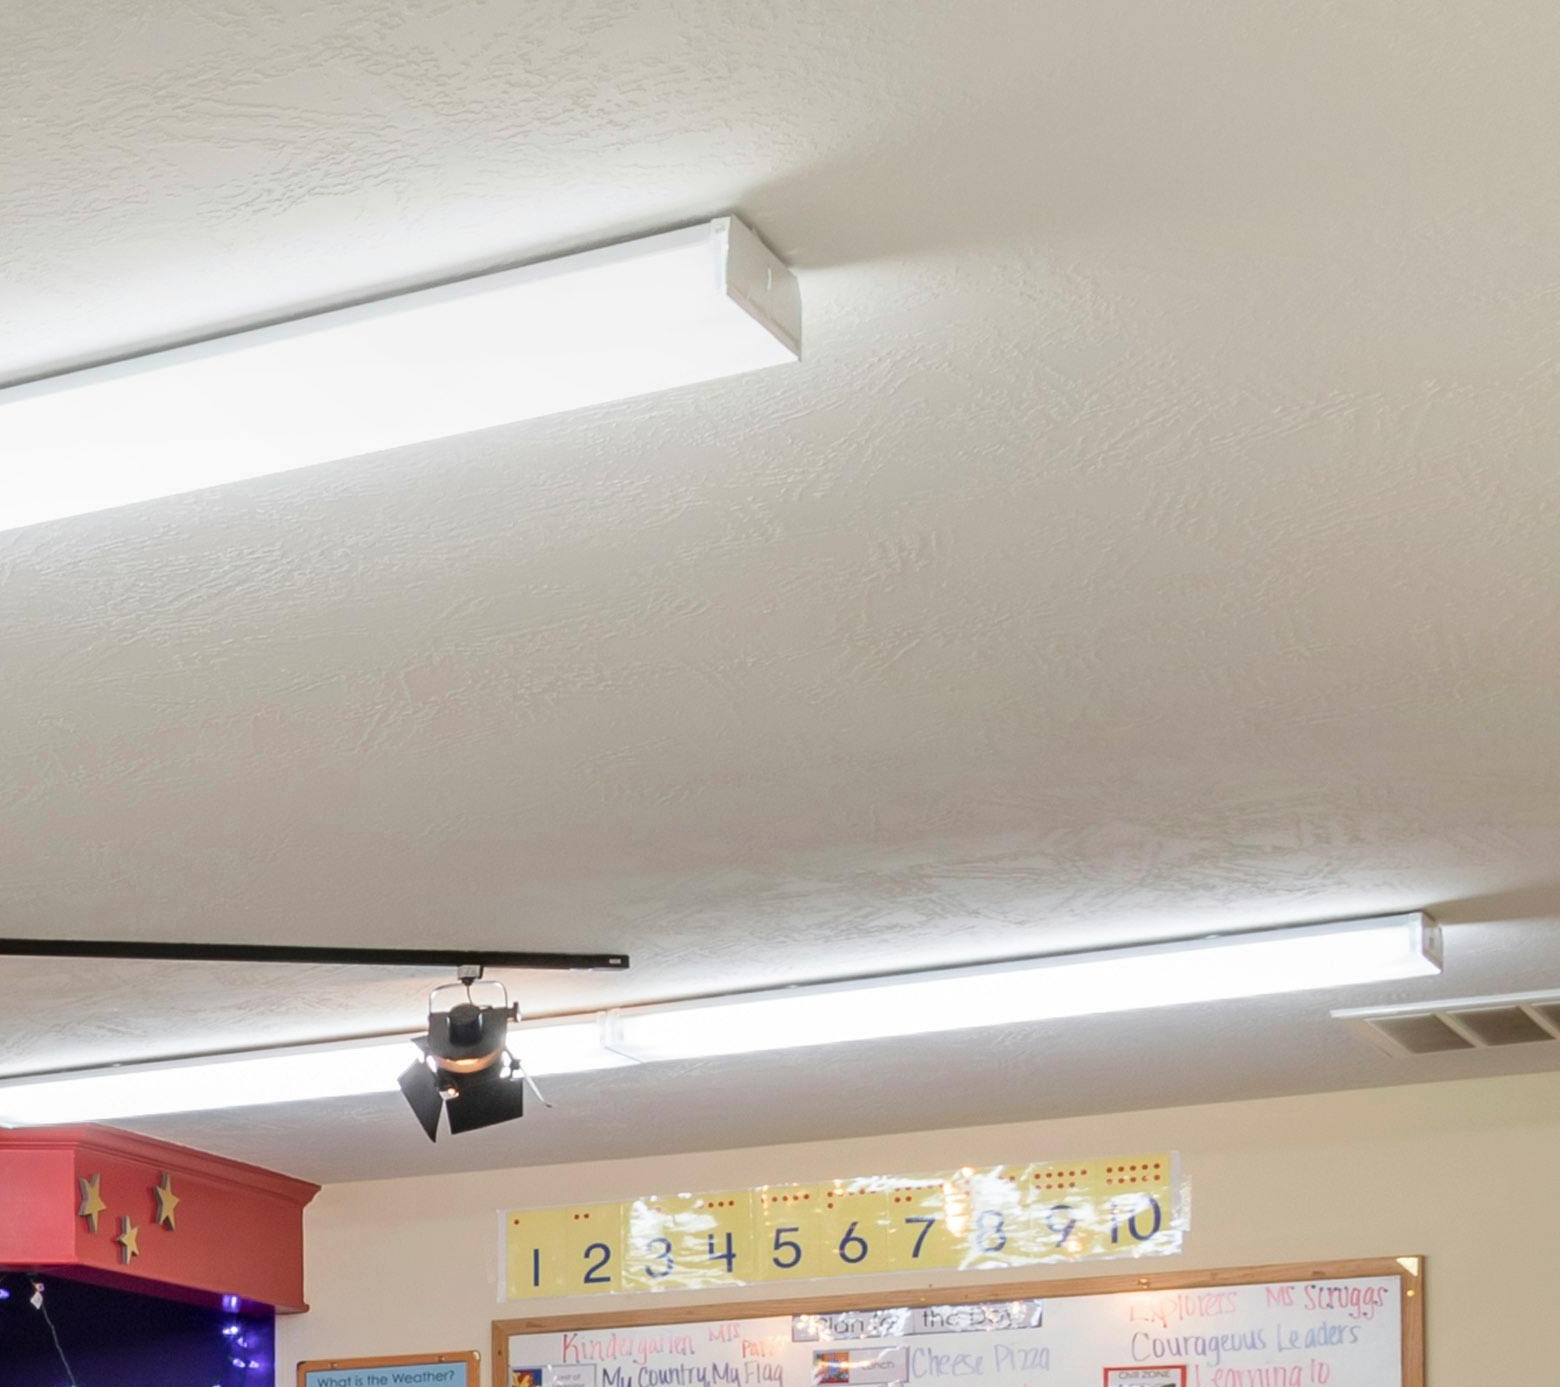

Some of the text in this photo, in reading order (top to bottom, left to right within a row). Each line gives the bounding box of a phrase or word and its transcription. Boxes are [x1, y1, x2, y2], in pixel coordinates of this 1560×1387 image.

[532, 1196, 1163, 1287] 1 2 3 4 5 6 7 8 9 10
[1303, 1284, 1389, 1320] Scruggs
[911, 1344, 1051, 1379] Cheese Pizza
[1131, 1322, 1362, 1366] Courageous Leaders
[354, 1374, 364, 1386] is
[367, 1373, 389, 1386] the
[392, 1370, 456, 1385] Weather?
